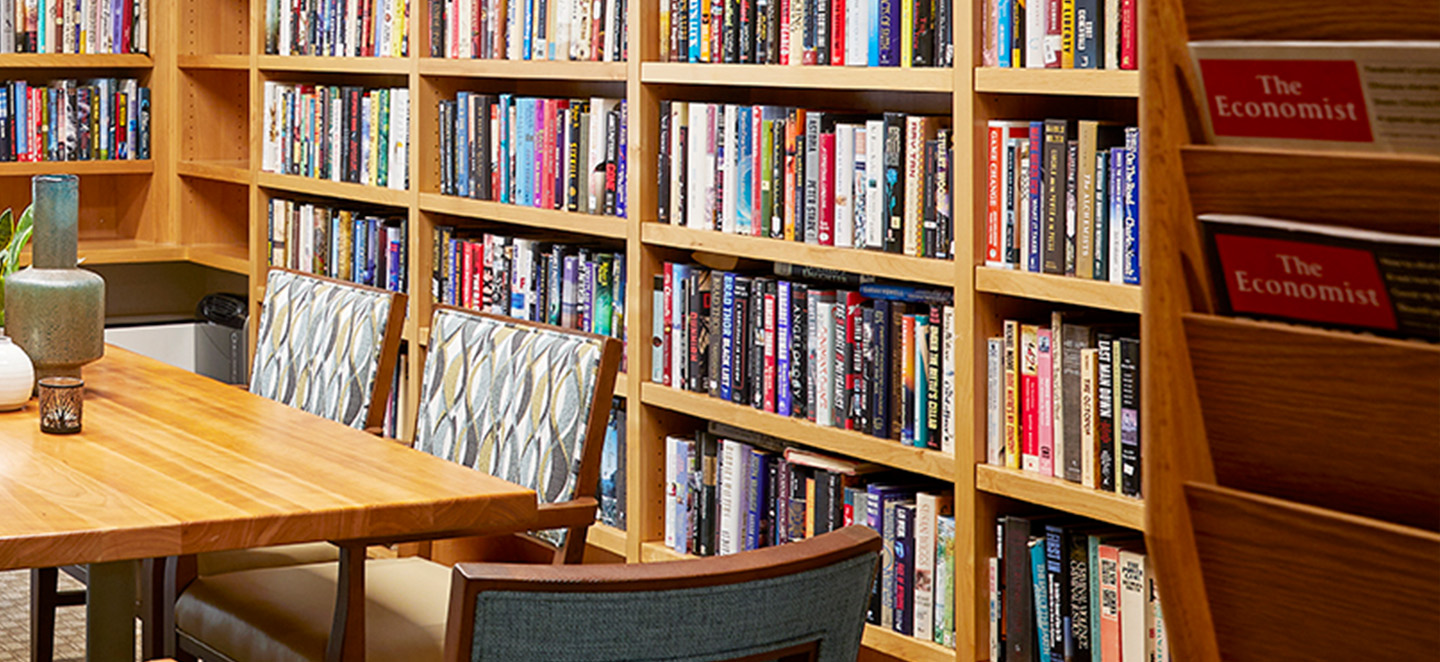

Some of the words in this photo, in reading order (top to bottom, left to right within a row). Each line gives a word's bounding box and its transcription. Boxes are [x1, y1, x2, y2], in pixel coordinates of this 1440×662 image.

[1063, 8, 1071, 53] LIBERTY
[1256, 74, 1302, 95] The
[1215, 95, 1358, 121] Economist
[808, 119, 816, 152] ASTORIA
[937, 132, 946, 168] STUART
[606, 163, 616, 192] GONE
[808, 180, 816, 203] PETER
[1277, 254, 1323, 278] The
[723, 276, 731, 305] BRAD
[1235, 271, 1380, 307] Economist
[723, 307, 731, 336] THOR
[930, 325, 938, 351] UNDER
[1099, 340, 1110, 362] LAST
[1099, 363, 1110, 386] MAN
[1099, 388, 1111, 418] DOWN
[1047, 534, 1061, 559] FIRST
[1048, 561, 1061, 573] IN
